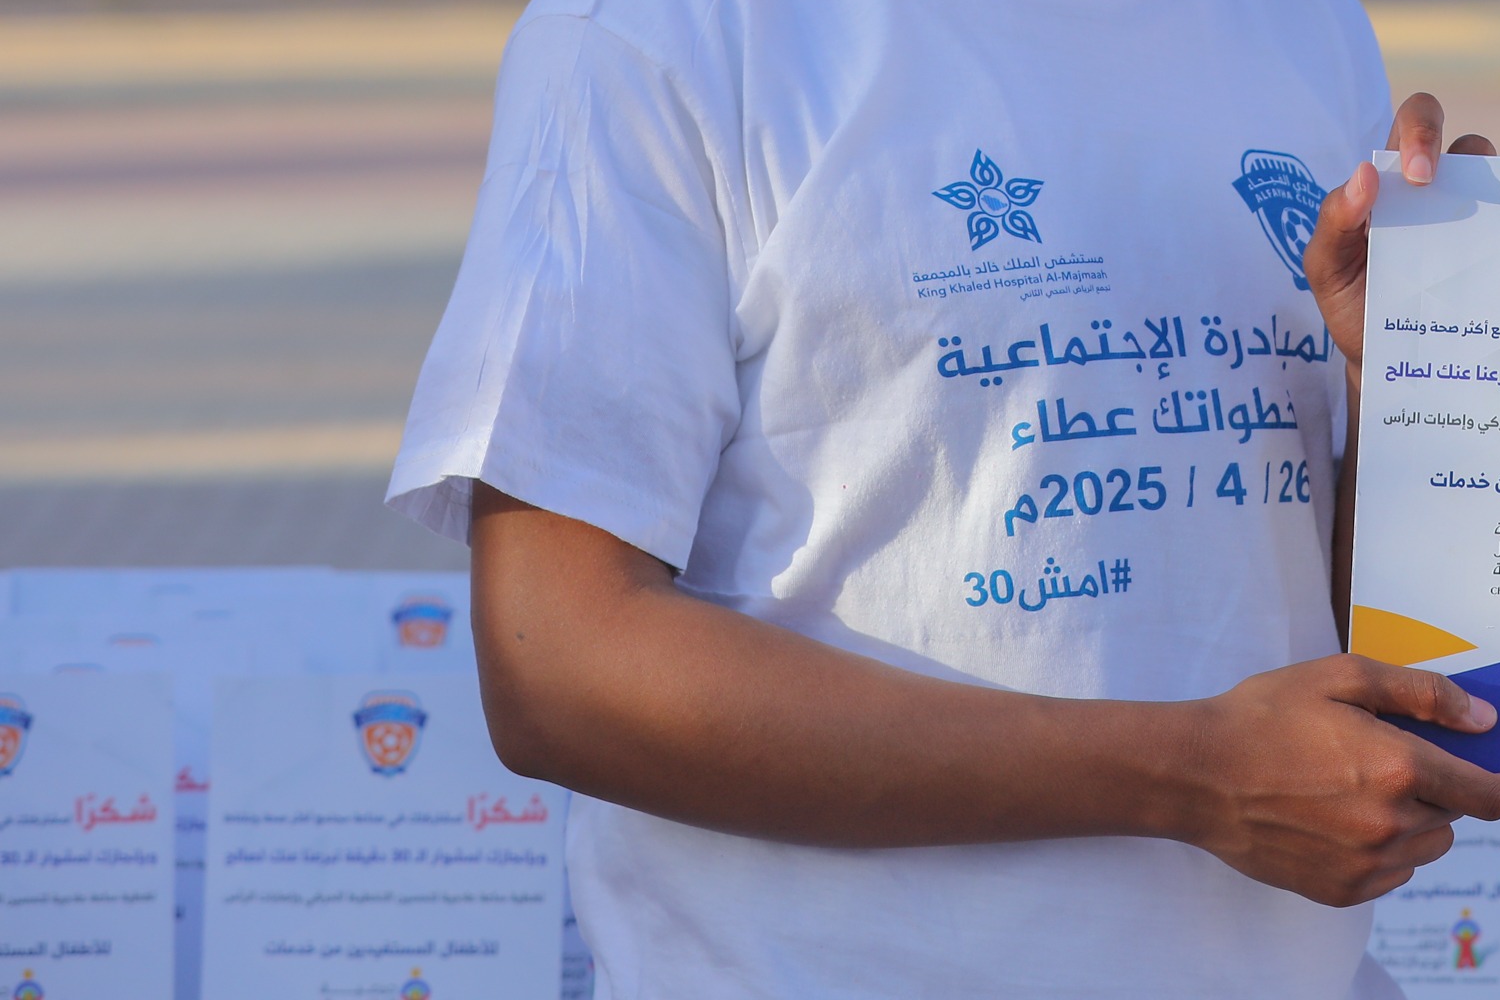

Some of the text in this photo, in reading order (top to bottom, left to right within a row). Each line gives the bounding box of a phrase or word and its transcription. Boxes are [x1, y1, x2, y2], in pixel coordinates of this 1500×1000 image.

[1255, 188, 1293, 203] ALFAYHA
[912, 253, 1104, 283] مستشفى الملك خالد بالمجمعة
[917, 270, 1108, 299] King Khaled Hospital Al-Majmaah
[1045, 287, 1070, 297] الصحي
[1073, 285, 1094, 295] الرياض
[1019, 289, 1043, 301] الثاني
[1384, 318, 1427, 335] ونشاط
[1430, 319, 1459, 334] صحة
[1461, 320, 1488, 337] أكثر
[936, 314, 1334, 387] لمبادرة الإجتماعية
[1385, 361, 1432, 381] لصالح
[1436, 363, 1471, 380] عنك
[1011, 397, 1138, 451] عطاء
[1383, 408, 1421, 427] الرأس
[1423, 412, 1474, 430] وإصابات
[1216, 462, 1247, 505] 4
[1278, 460, 1310, 503] 26
[1430, 471, 1490, 490] خدمات
[1004, 466, 1167, 537] 2025م
